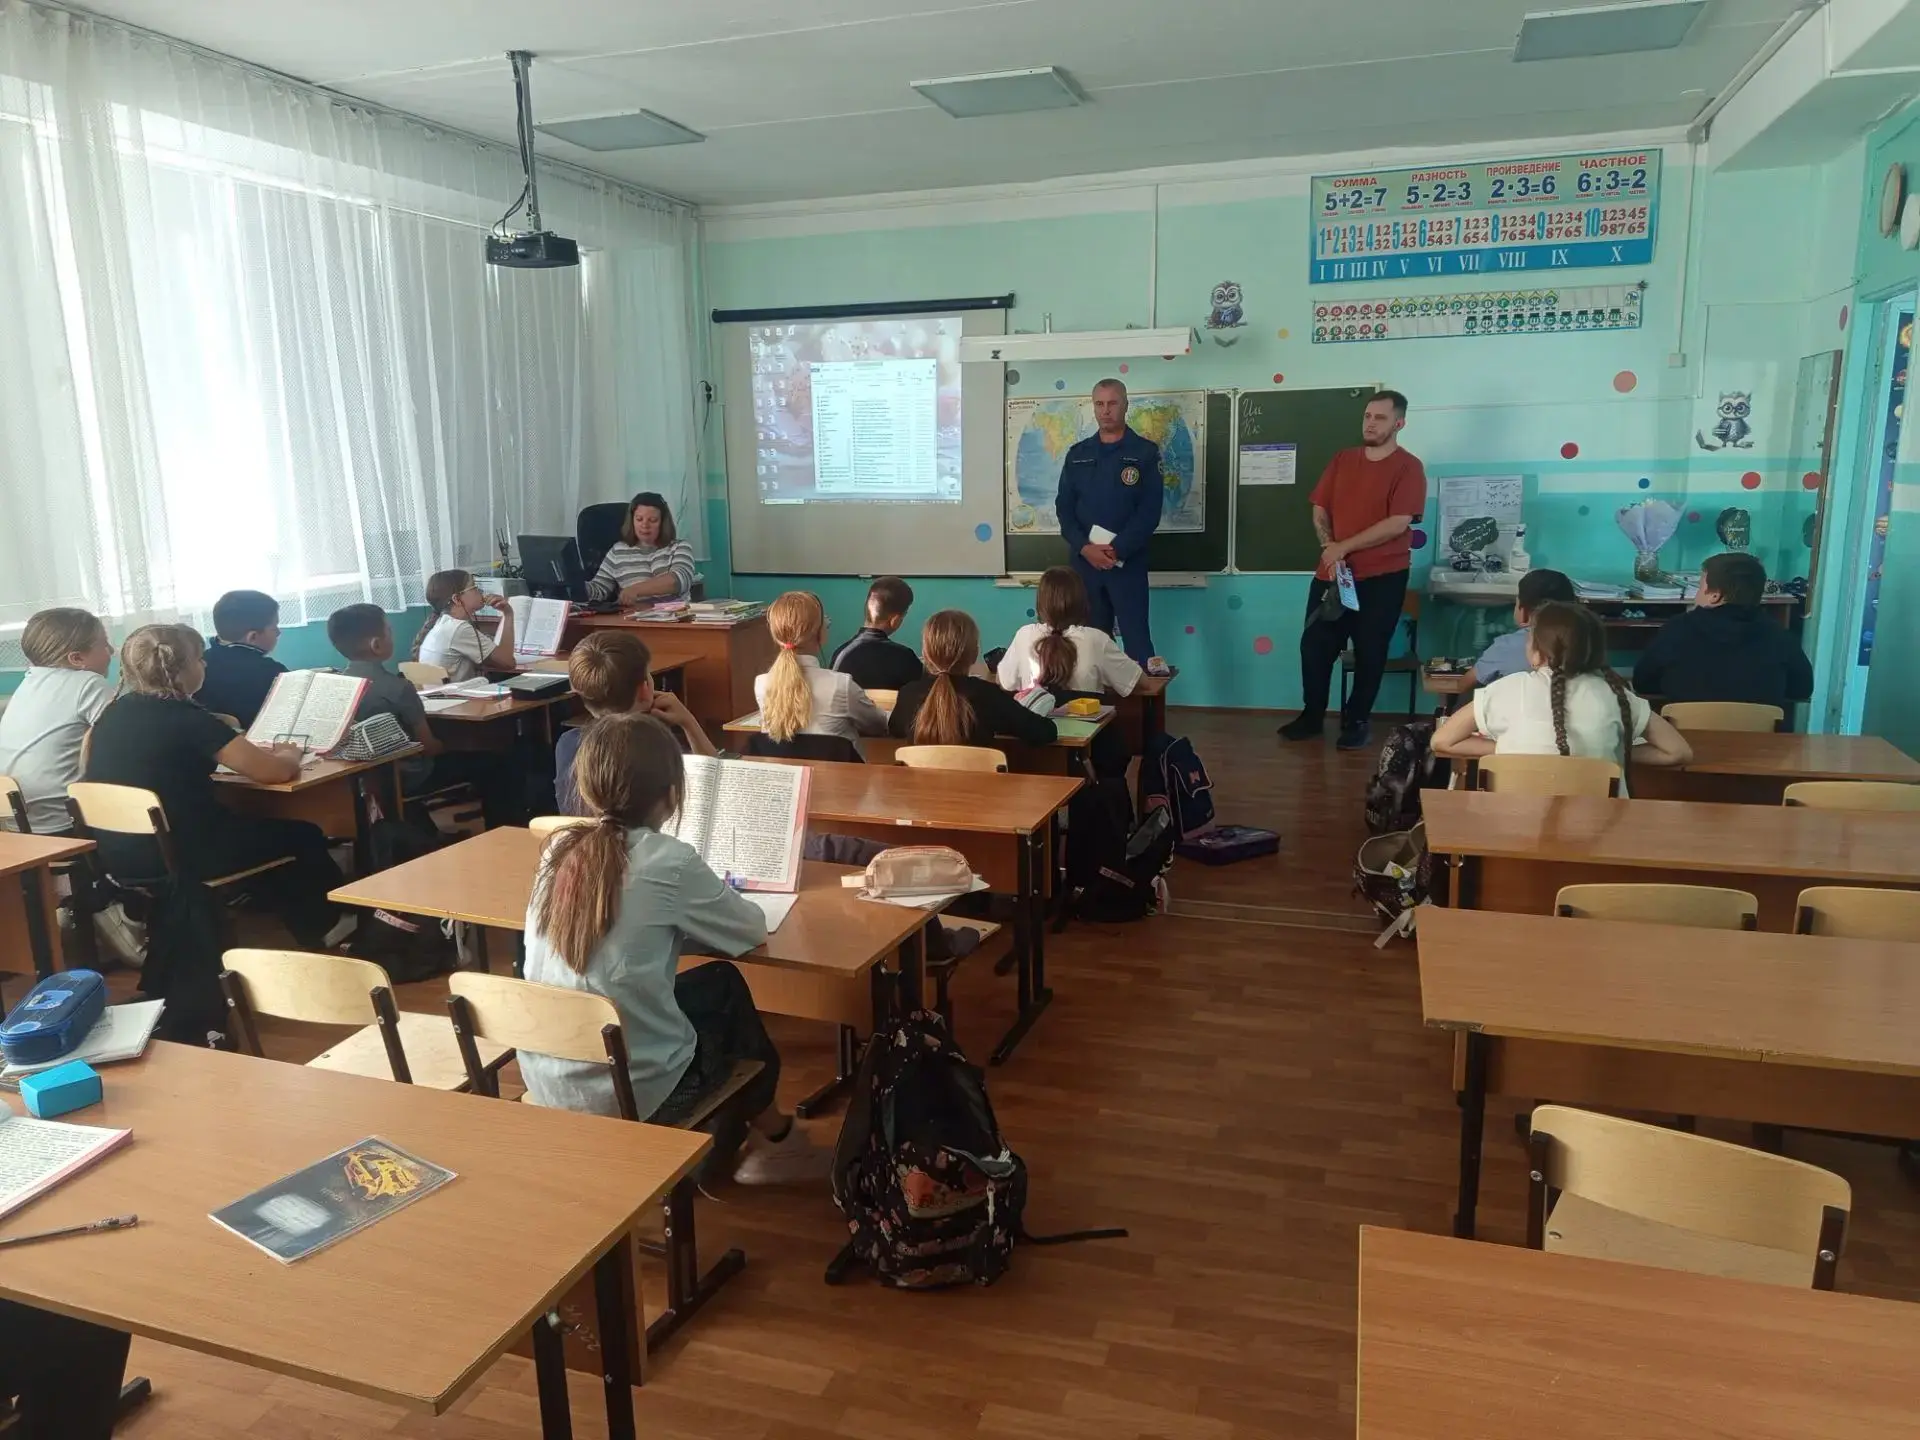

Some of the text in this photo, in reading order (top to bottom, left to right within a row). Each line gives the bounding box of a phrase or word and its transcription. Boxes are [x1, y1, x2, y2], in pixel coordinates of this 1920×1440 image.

[1579, 156, 1647, 168] ЧАСТНОЕ
[1487, 162, 1561, 176] ПРОИЗВЕДЕНИЕ
[1411, 170, 1467, 182] РАЗНОСТЬ
[1334, 178, 1377, 188] СУММА
[1392, 222, 1400, 249] 5
[1419, 220, 1427, 247] 6
[1491, 214, 1499, 242] 8
[1537, 211, 1546, 240] 9
[1584, 208, 1600, 236] 10
[1334, 263, 1345, 279] II
[1351, 262, 1367, 278] III
[1372, 260, 1387, 277] IV
[1400, 258, 1410, 274] V
[1428, 256, 1443, 273] VI
[1459, 254, 1480, 271] VII
[1498, 252, 1527, 268] VIII
[1552, 249, 1569, 266] IX
[1611, 246, 1623, 262] X
